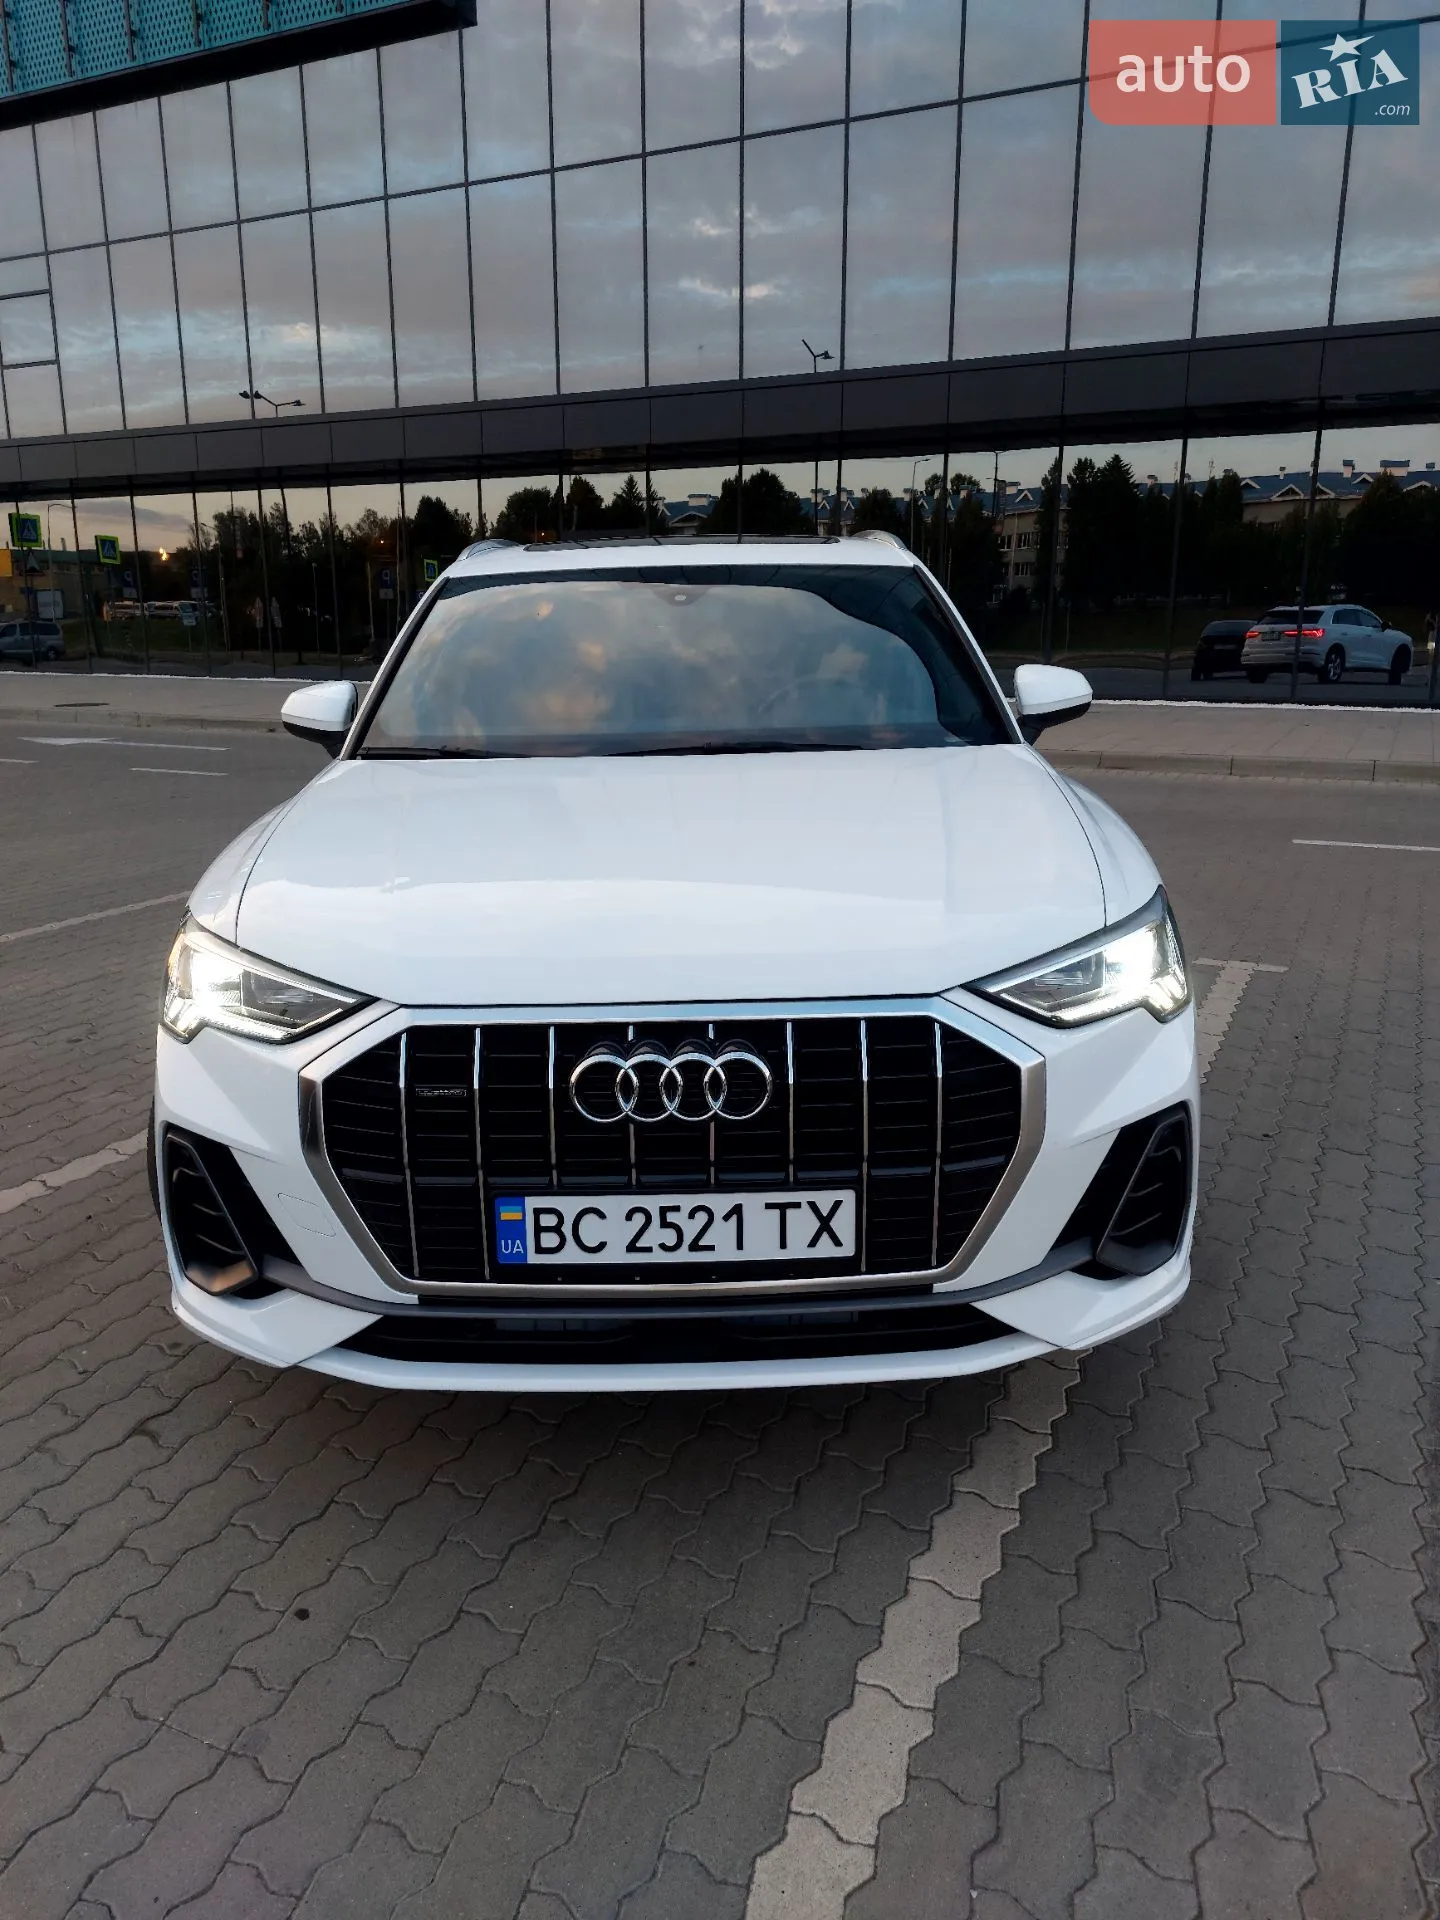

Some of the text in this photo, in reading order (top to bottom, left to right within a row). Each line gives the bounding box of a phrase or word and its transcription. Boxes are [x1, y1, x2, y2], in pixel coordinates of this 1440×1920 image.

[532, 1199, 844, 1255] BC 2521 TX
[500, 1239, 524, 1255] UA
